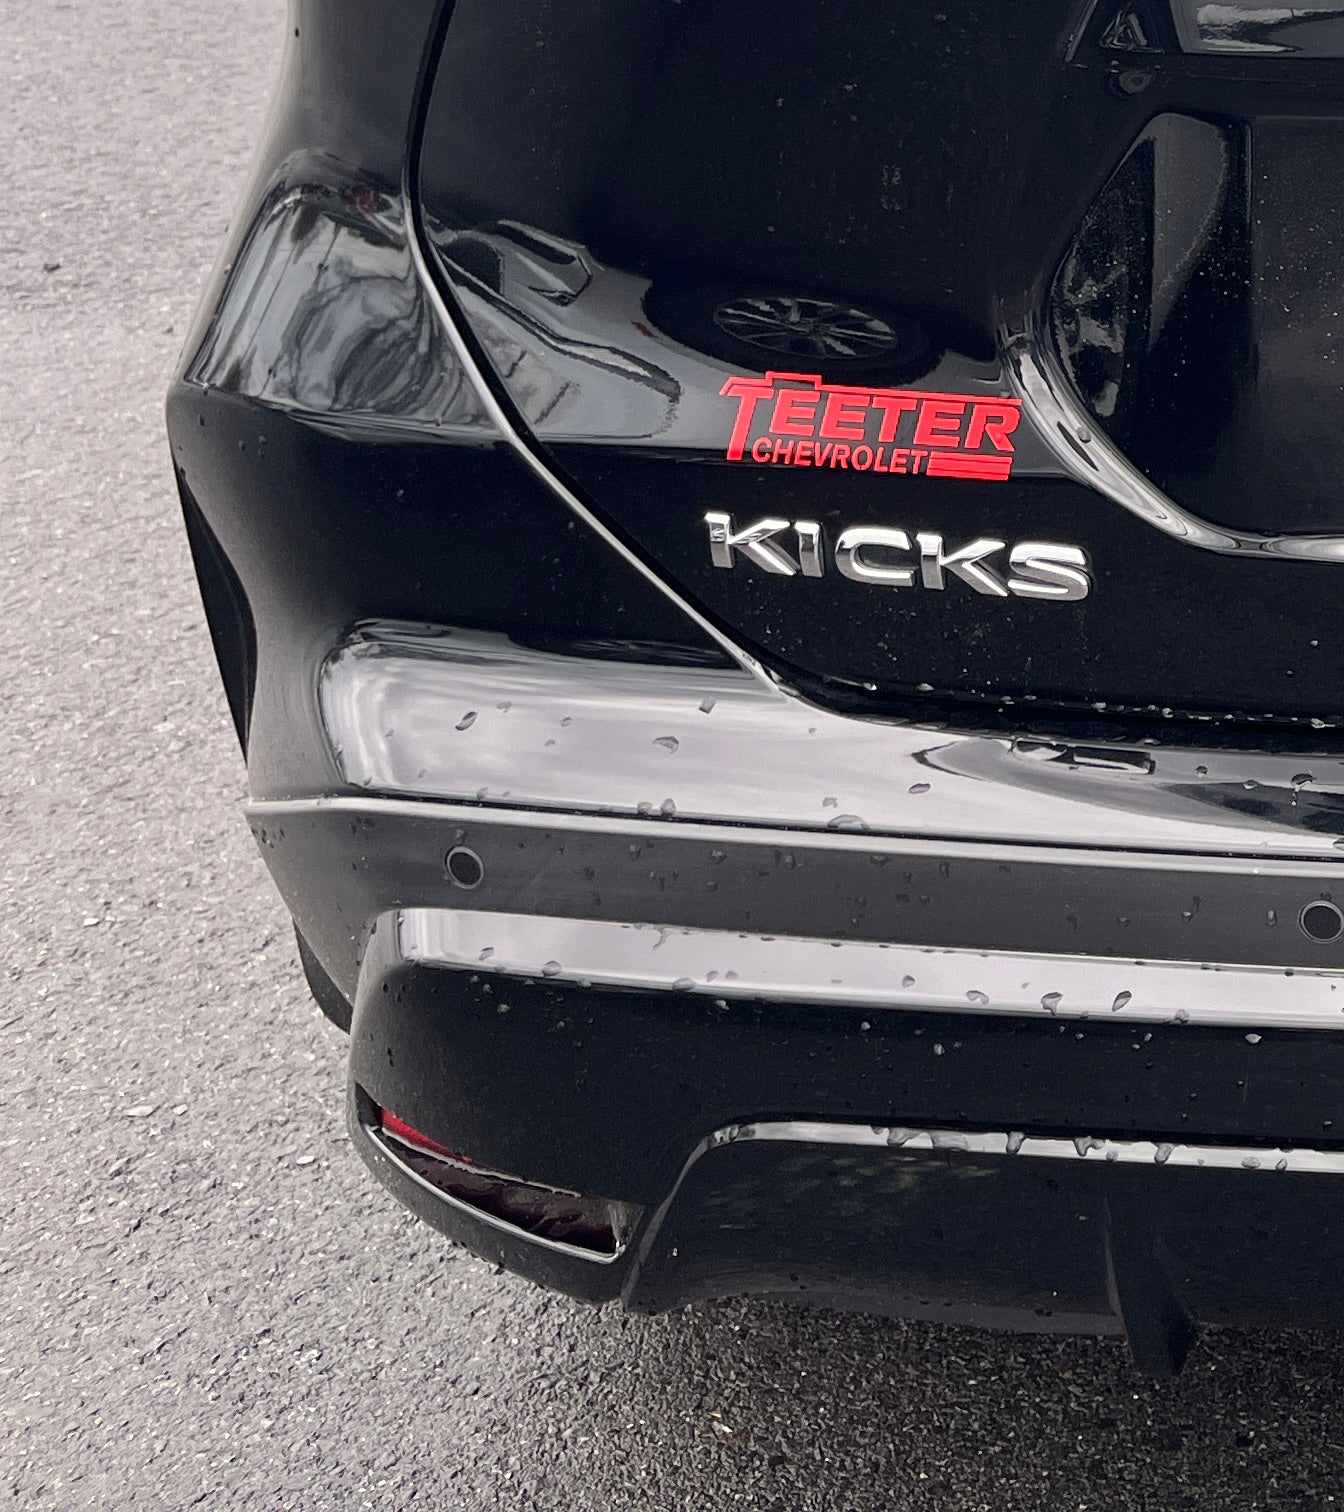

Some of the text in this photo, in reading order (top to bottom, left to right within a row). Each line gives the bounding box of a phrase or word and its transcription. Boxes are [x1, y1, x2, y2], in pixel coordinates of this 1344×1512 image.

[722, 382, 1022, 463] TEETER
[751, 437, 928, 475] CHEVROLET
[703, 511, 1092, 603] KICKS
